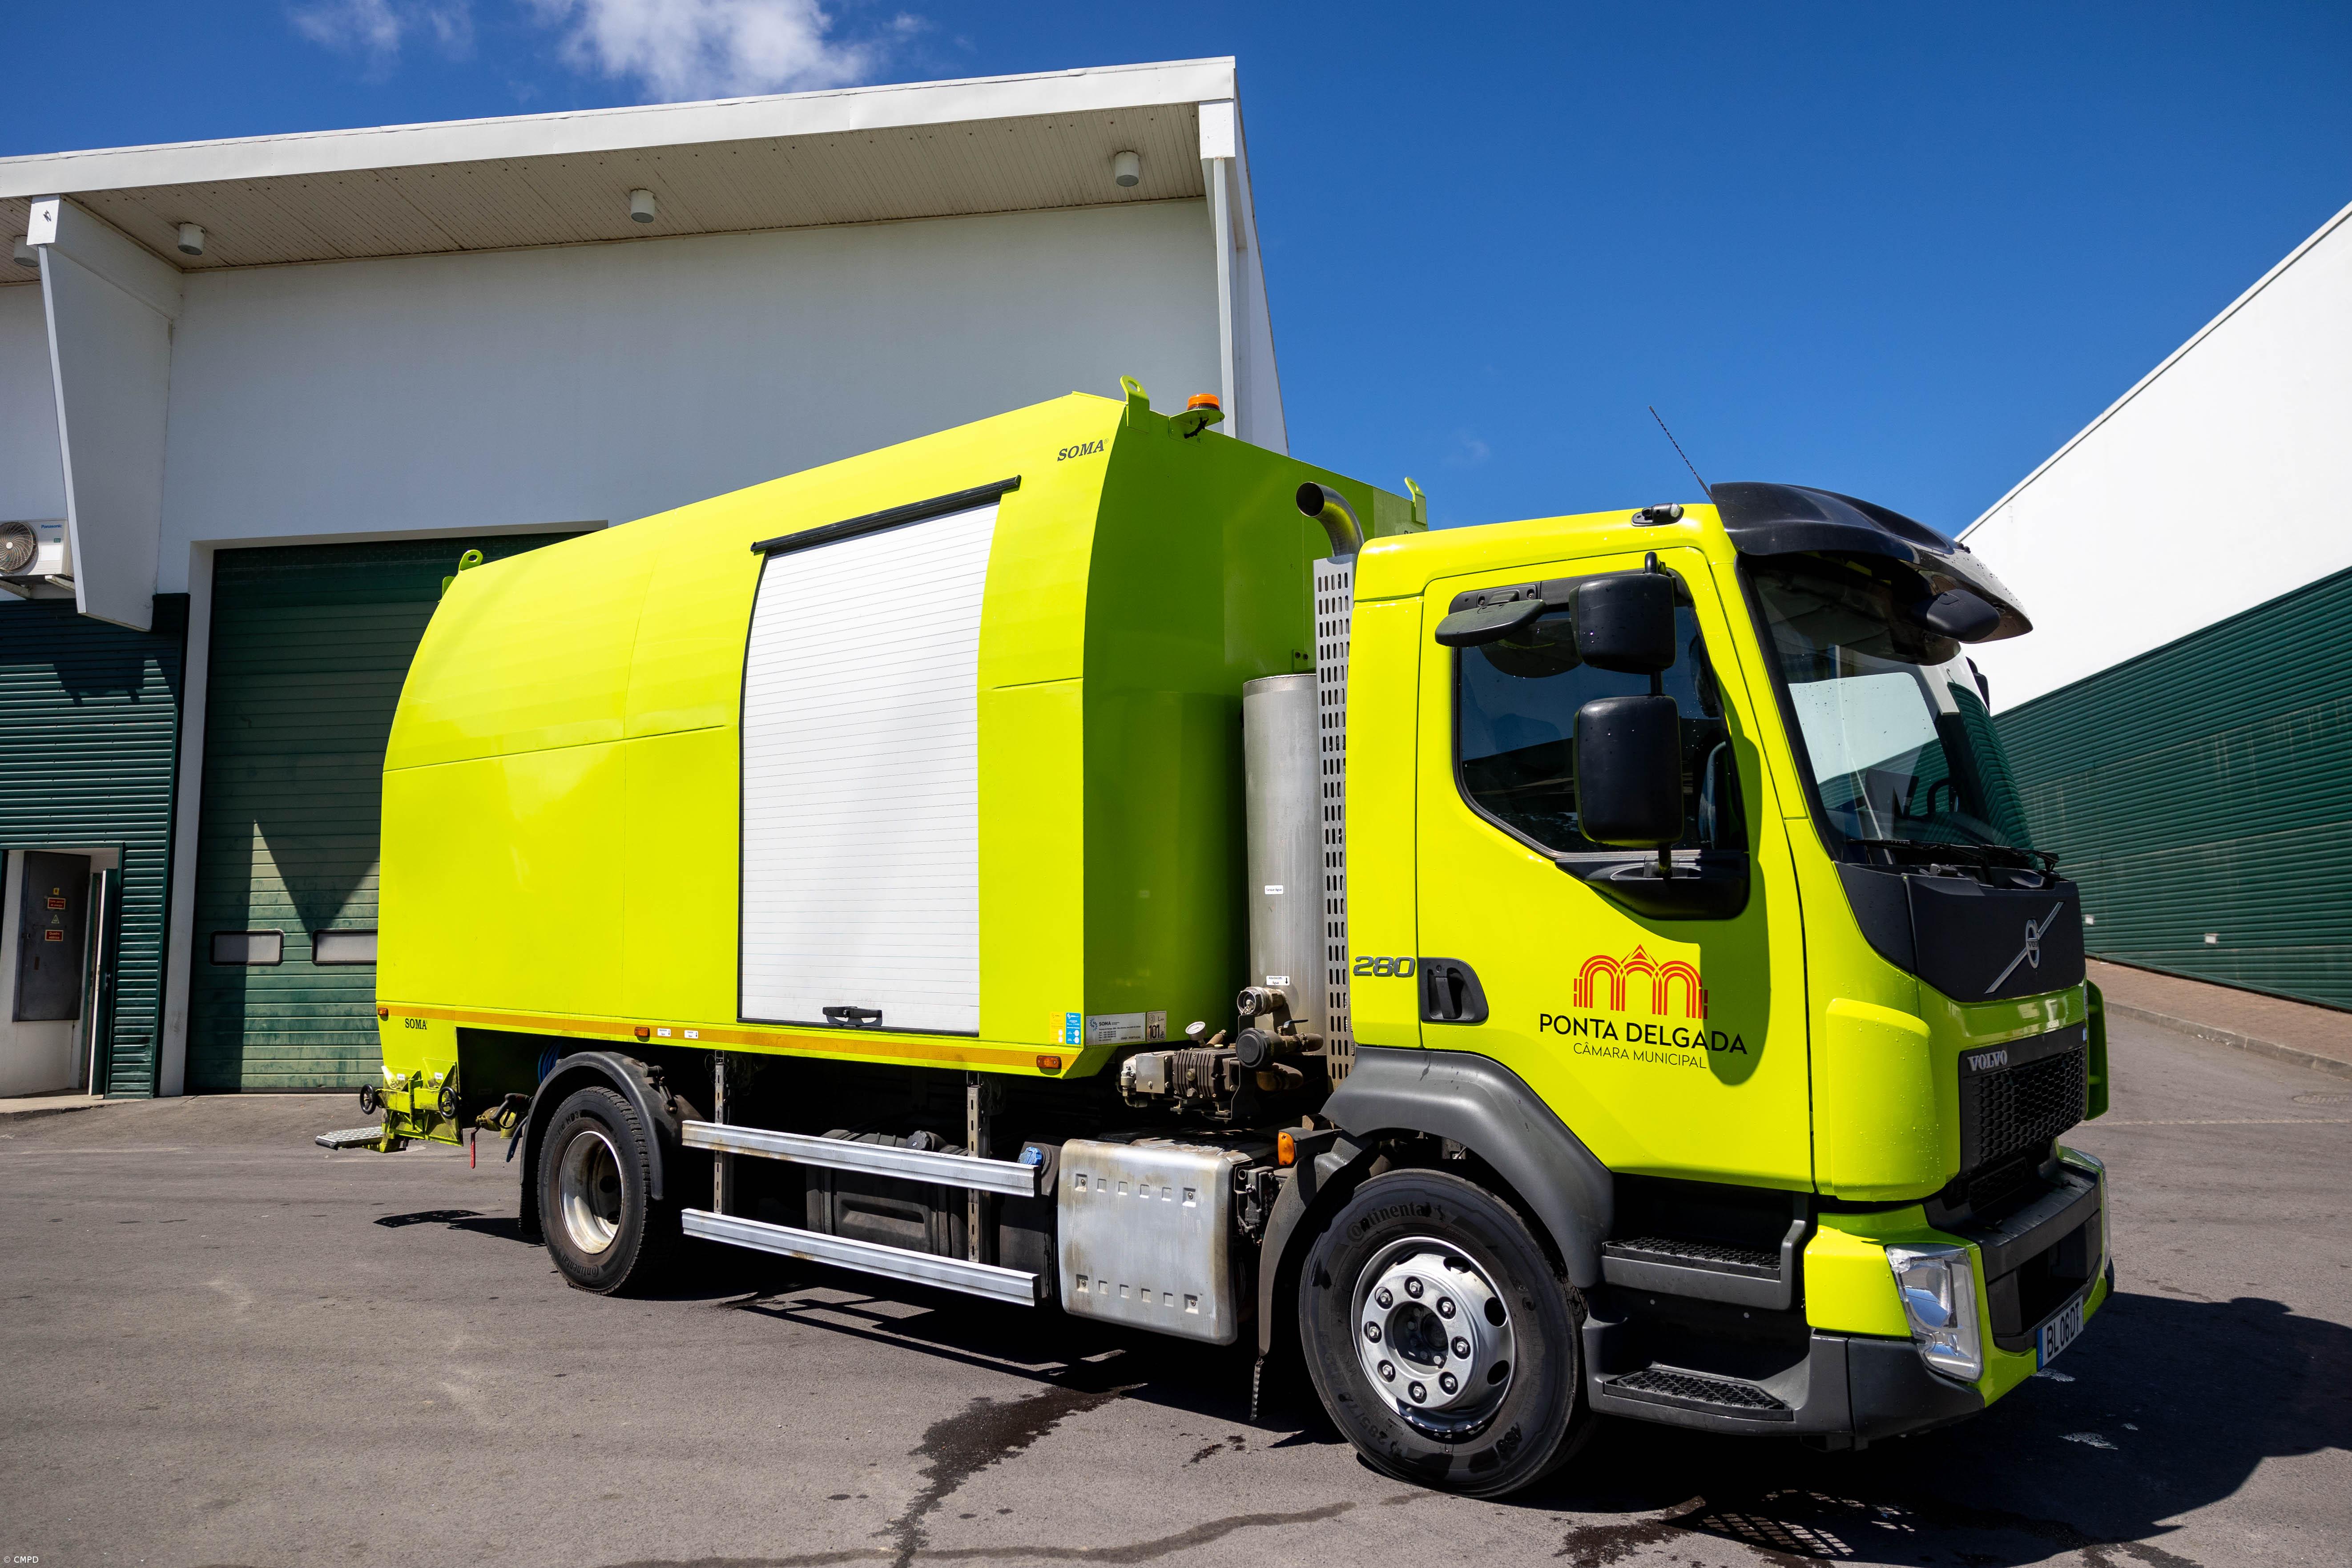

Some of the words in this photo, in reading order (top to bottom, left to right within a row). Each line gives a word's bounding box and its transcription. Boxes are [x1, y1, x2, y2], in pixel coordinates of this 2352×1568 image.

[1353, 956, 1416, 977] 280
[405, 1018, 427, 1030] SOMA
[1149, 1024, 1160, 1039] 101
[1539, 1013, 1619, 1040] PONTA
[1626, 1022, 1748, 1055] DELGADA
[1573, 1041, 1629, 1060] CÂMARA
[1633, 1050, 1707, 1068] MUNICIPAL
[1967, 1049, 2008, 1072] VOLVO
[1346, 1202, 1432, 1243] Continental
